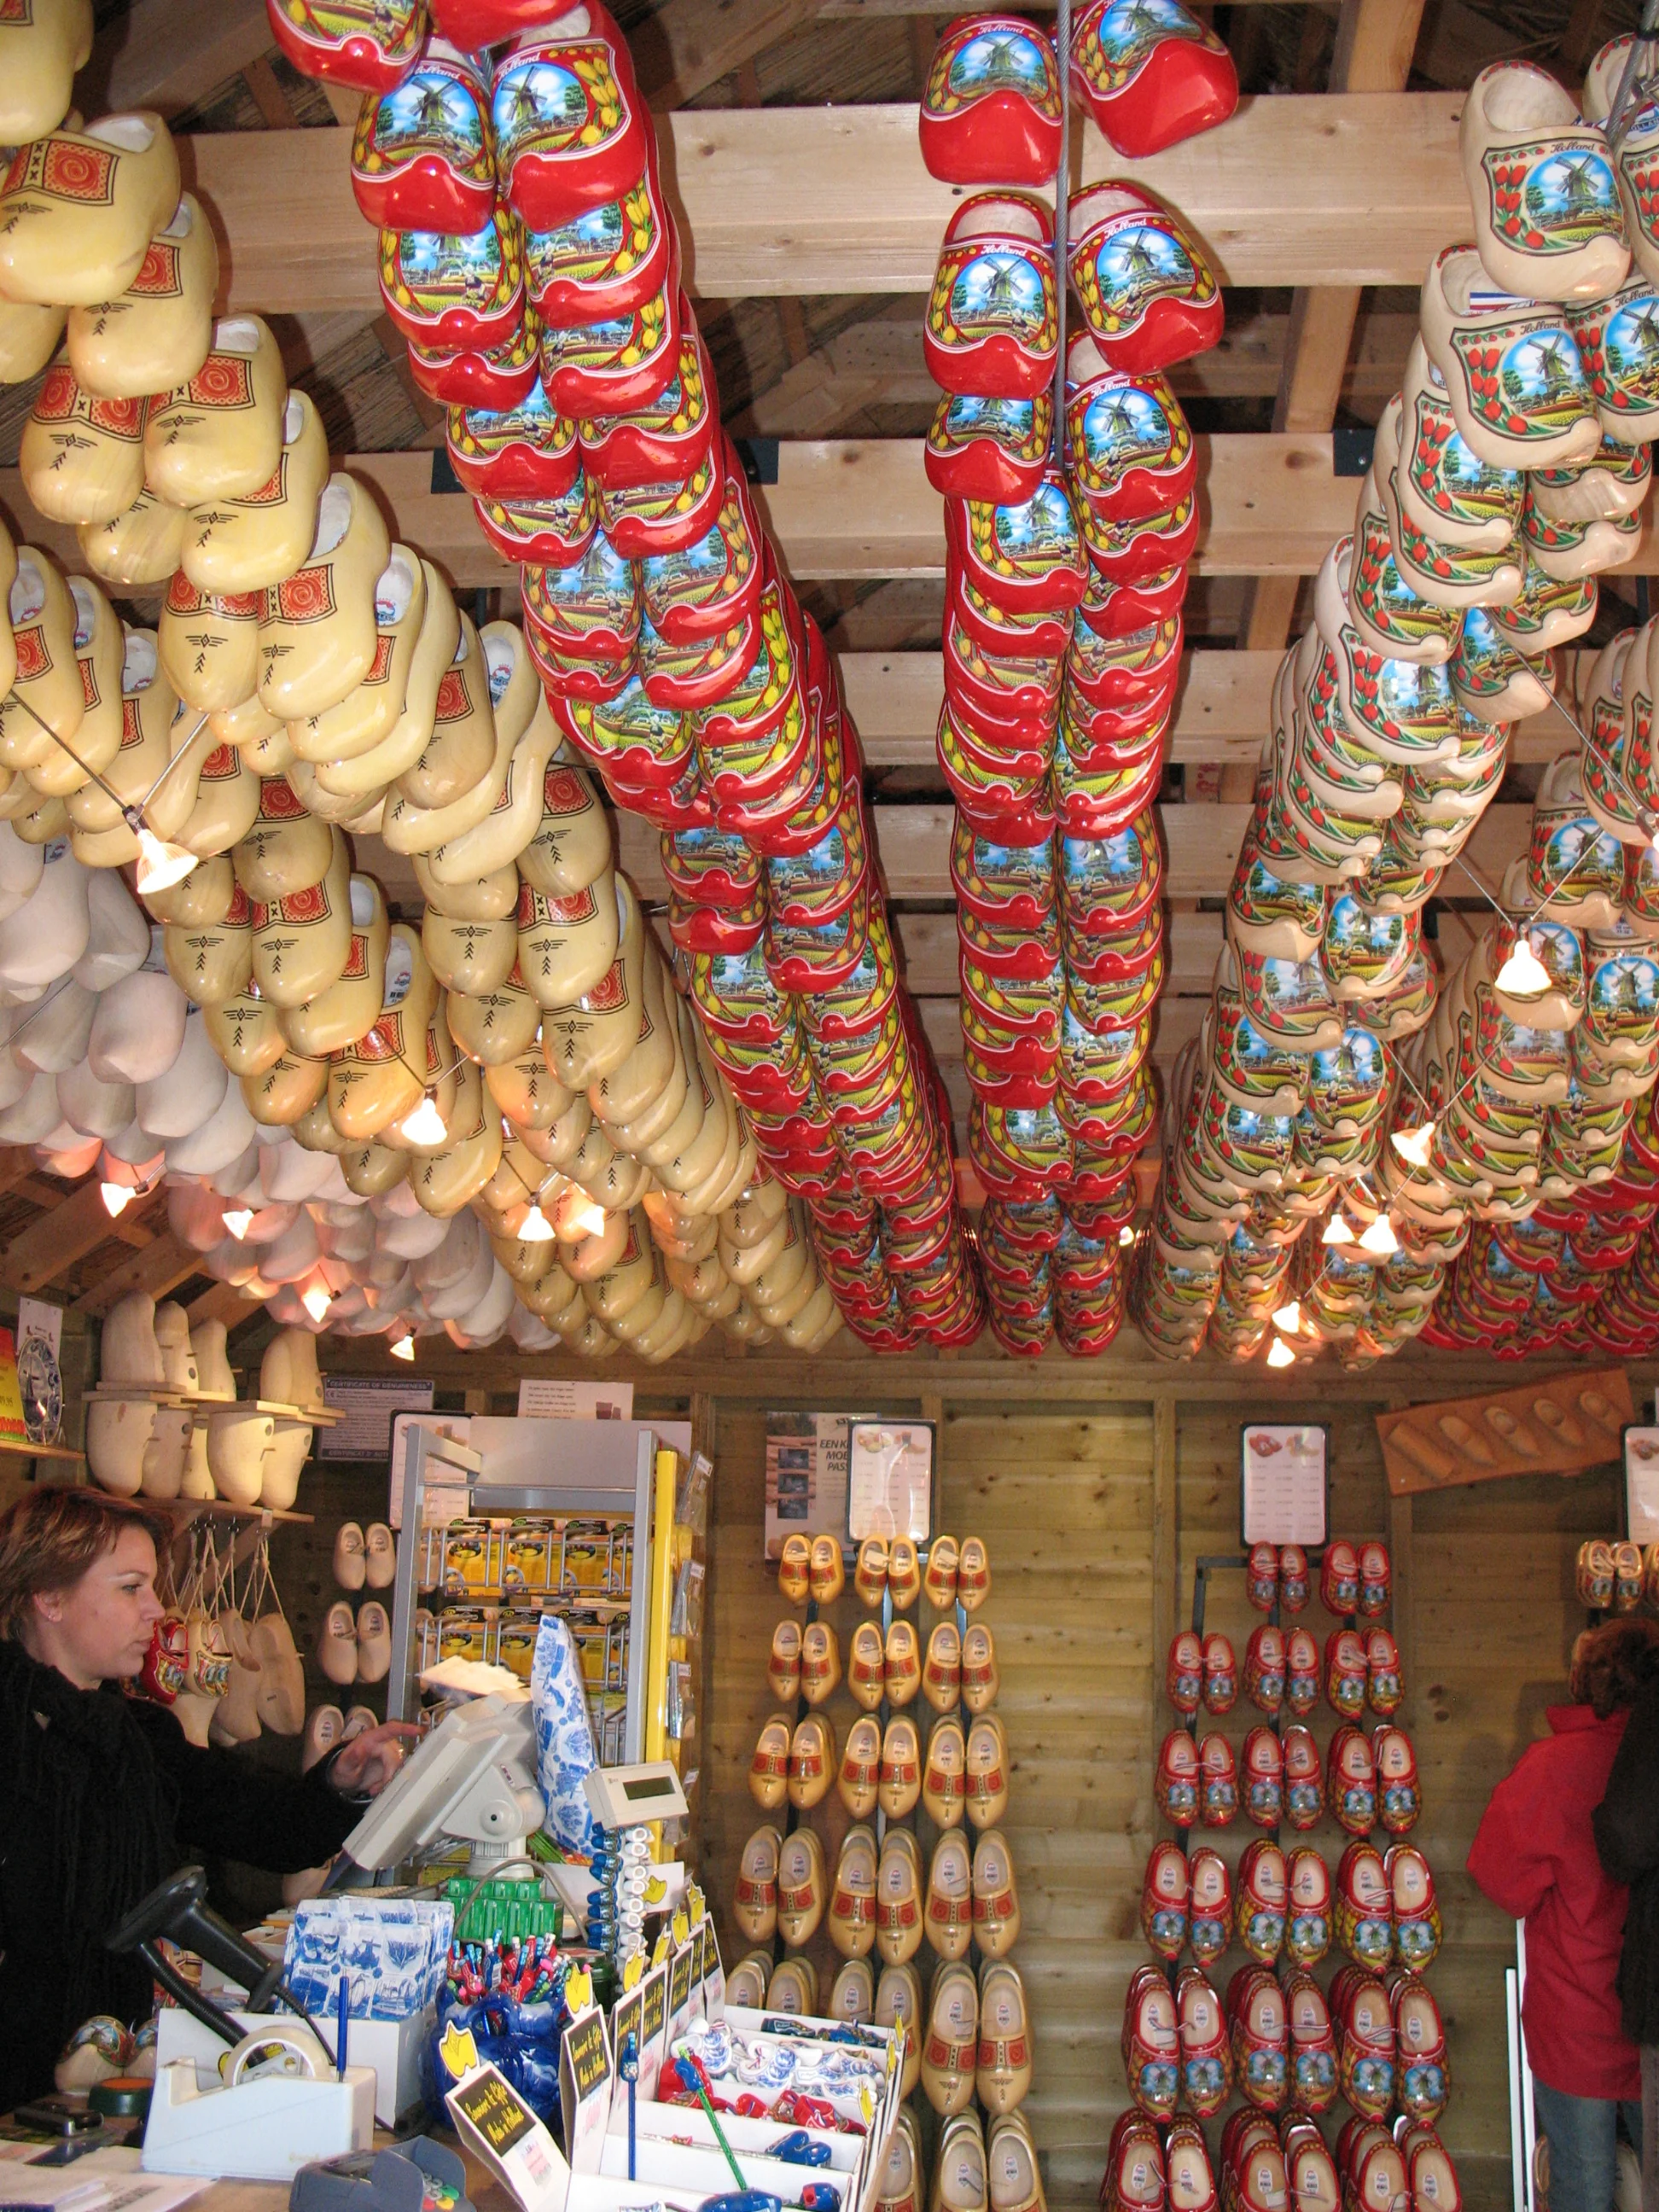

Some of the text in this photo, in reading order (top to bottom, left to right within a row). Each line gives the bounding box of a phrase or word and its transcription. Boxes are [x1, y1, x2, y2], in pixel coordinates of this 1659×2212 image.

[978, 24, 1025, 35] Holland
[498, 52, 540, 82] Holland
[1550, 141, 1595, 154] Holland
[1104, 218, 1148, 239] Holland
[981, 244, 1028, 257] Holland
[1615, 287, 1656, 308] Holland
[1520, 320, 1561, 335] Holland
[1091, 378, 1132, 399] Holland
[820, 1440, 841, 1448] EEN
[827, 1462, 848, 1471] PAS
